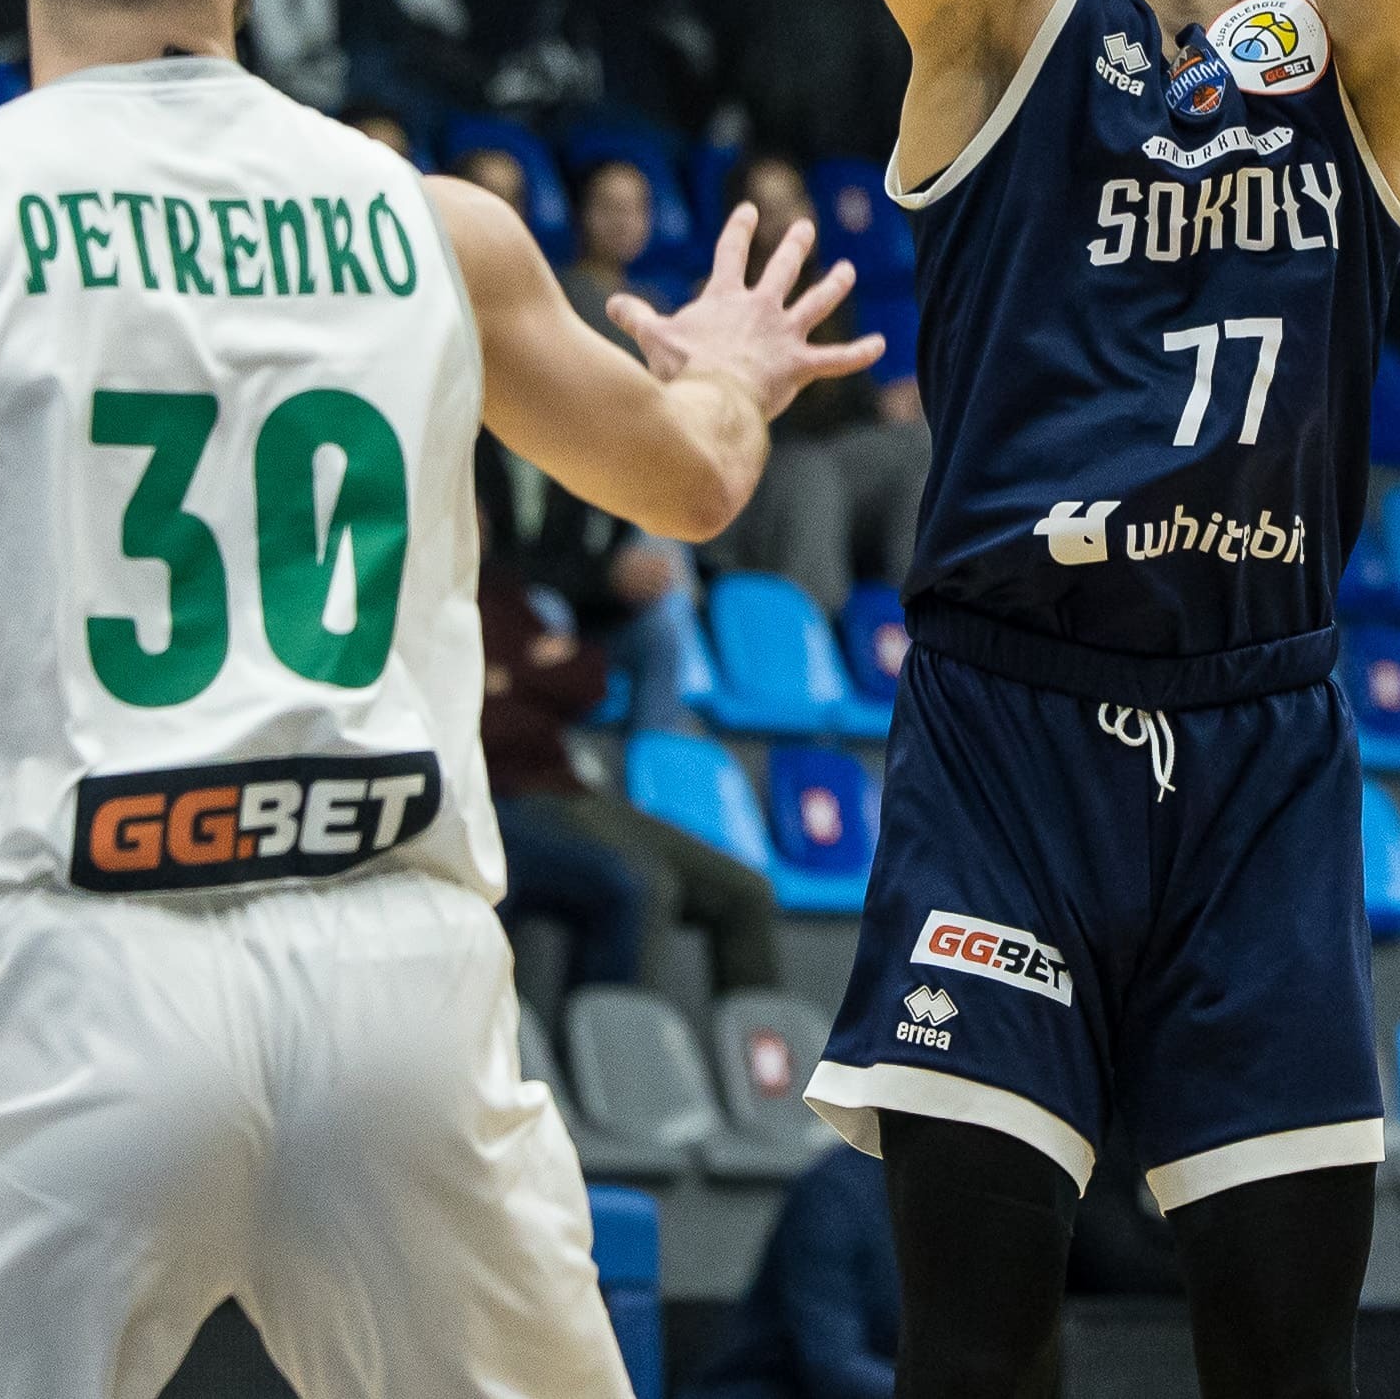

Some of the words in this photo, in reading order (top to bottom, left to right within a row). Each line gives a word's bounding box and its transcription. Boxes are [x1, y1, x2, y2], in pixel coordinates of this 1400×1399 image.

[1215, 0, 1288, 48] SUPERLEAGUE
[18, 191, 418, 297] PETRENKO
[1086, 162, 1342, 267] SOKOLY
[1163, 317, 1283, 447] 77
[86, 388, 409, 708] 30
